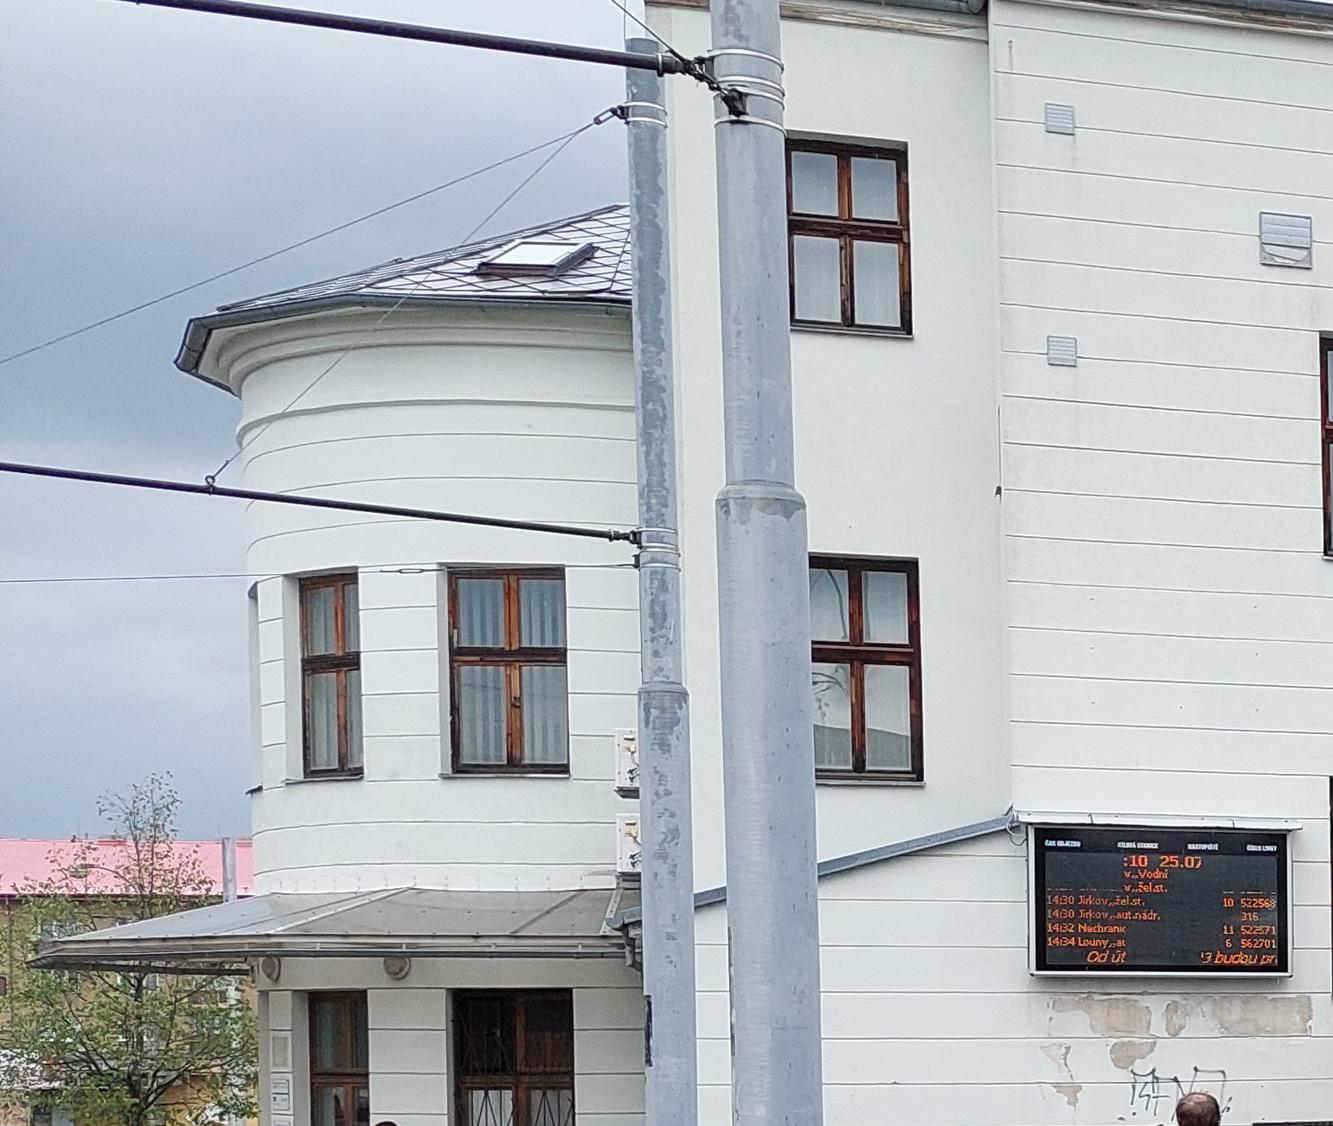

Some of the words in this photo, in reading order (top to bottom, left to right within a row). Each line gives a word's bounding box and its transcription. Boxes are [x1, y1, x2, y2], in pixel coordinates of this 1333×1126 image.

[1223, 898, 1234, 907] 10
[1223, 925, 1234, 934] 11
[1225, 938, 1232, 948] 6
